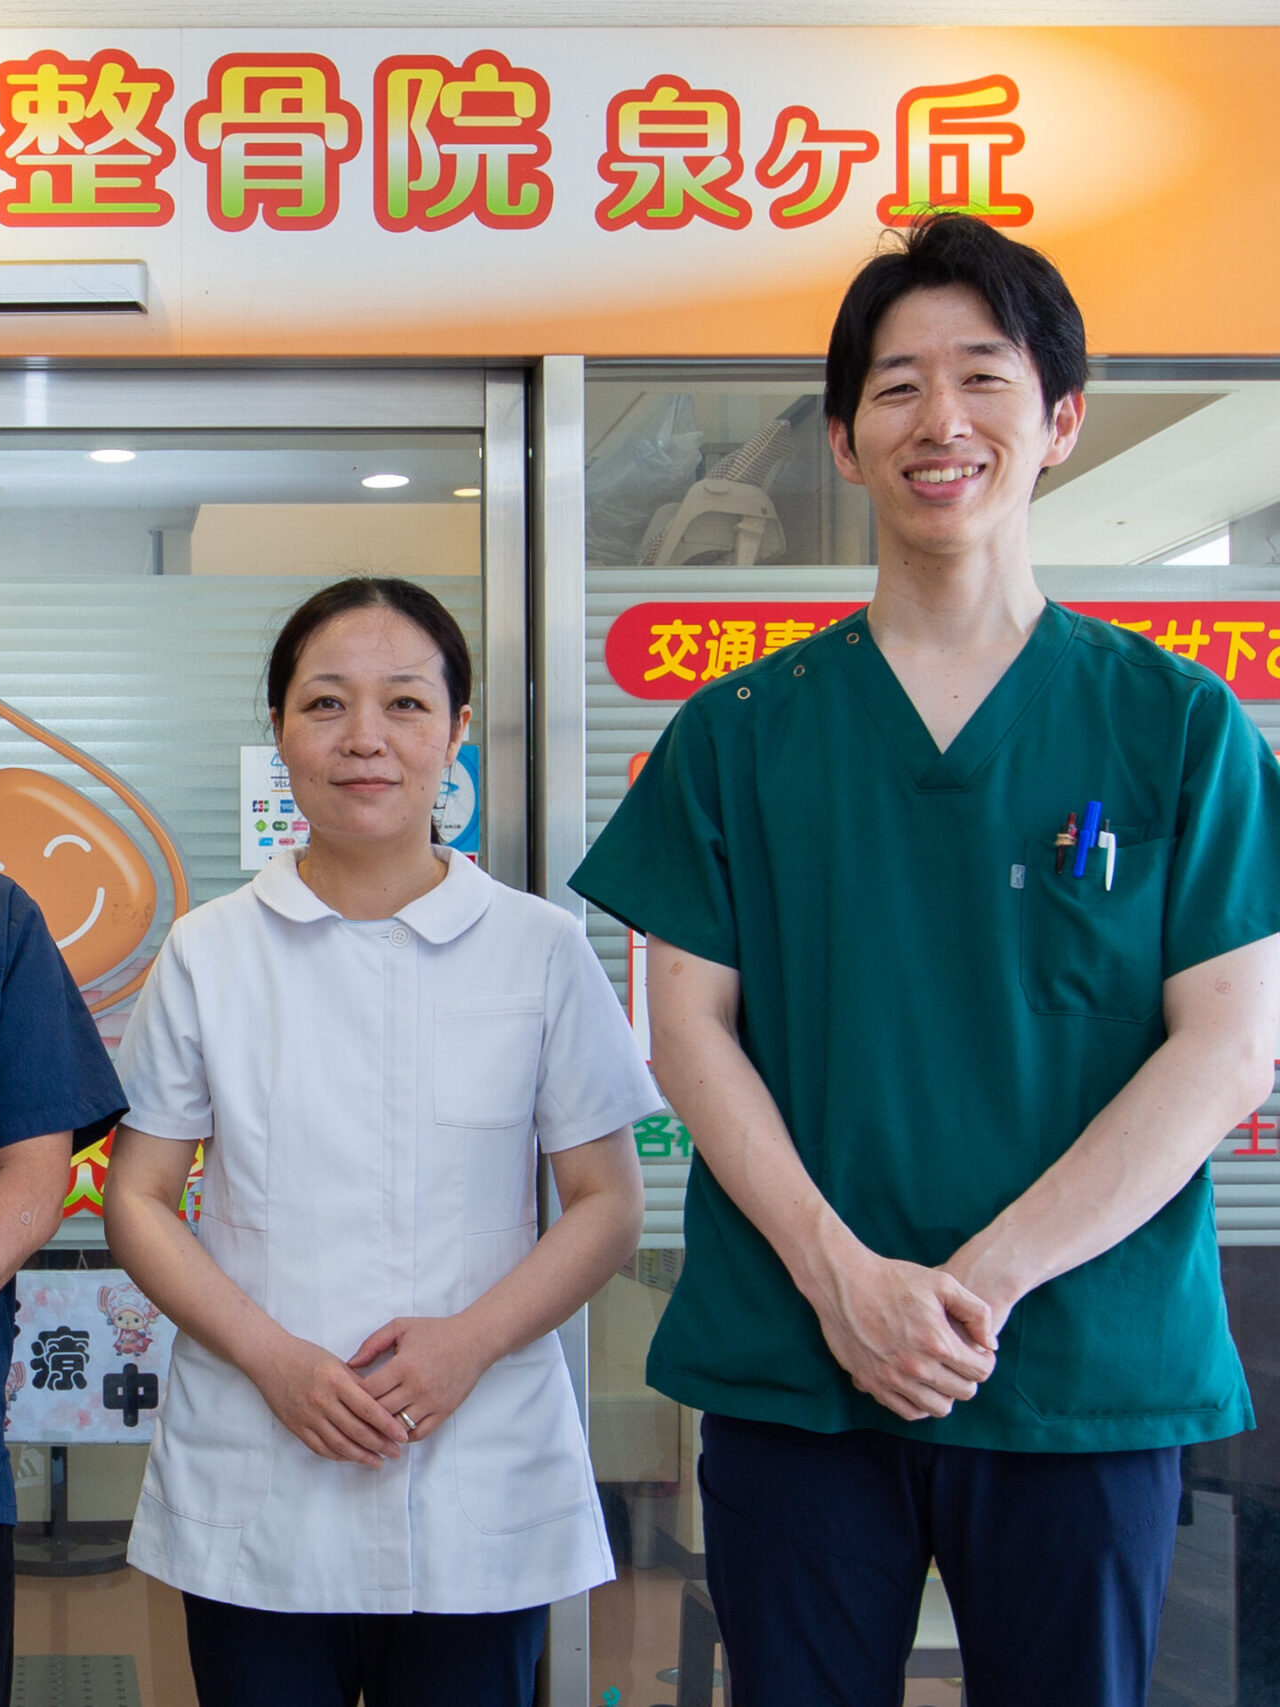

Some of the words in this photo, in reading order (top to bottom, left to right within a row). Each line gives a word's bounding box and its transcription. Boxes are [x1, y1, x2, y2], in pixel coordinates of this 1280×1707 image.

[1110, 618, 1280, 681] せ下
[633, 1115, 693, 1158] 各
[14, 1300, 159, 1427] 療中
